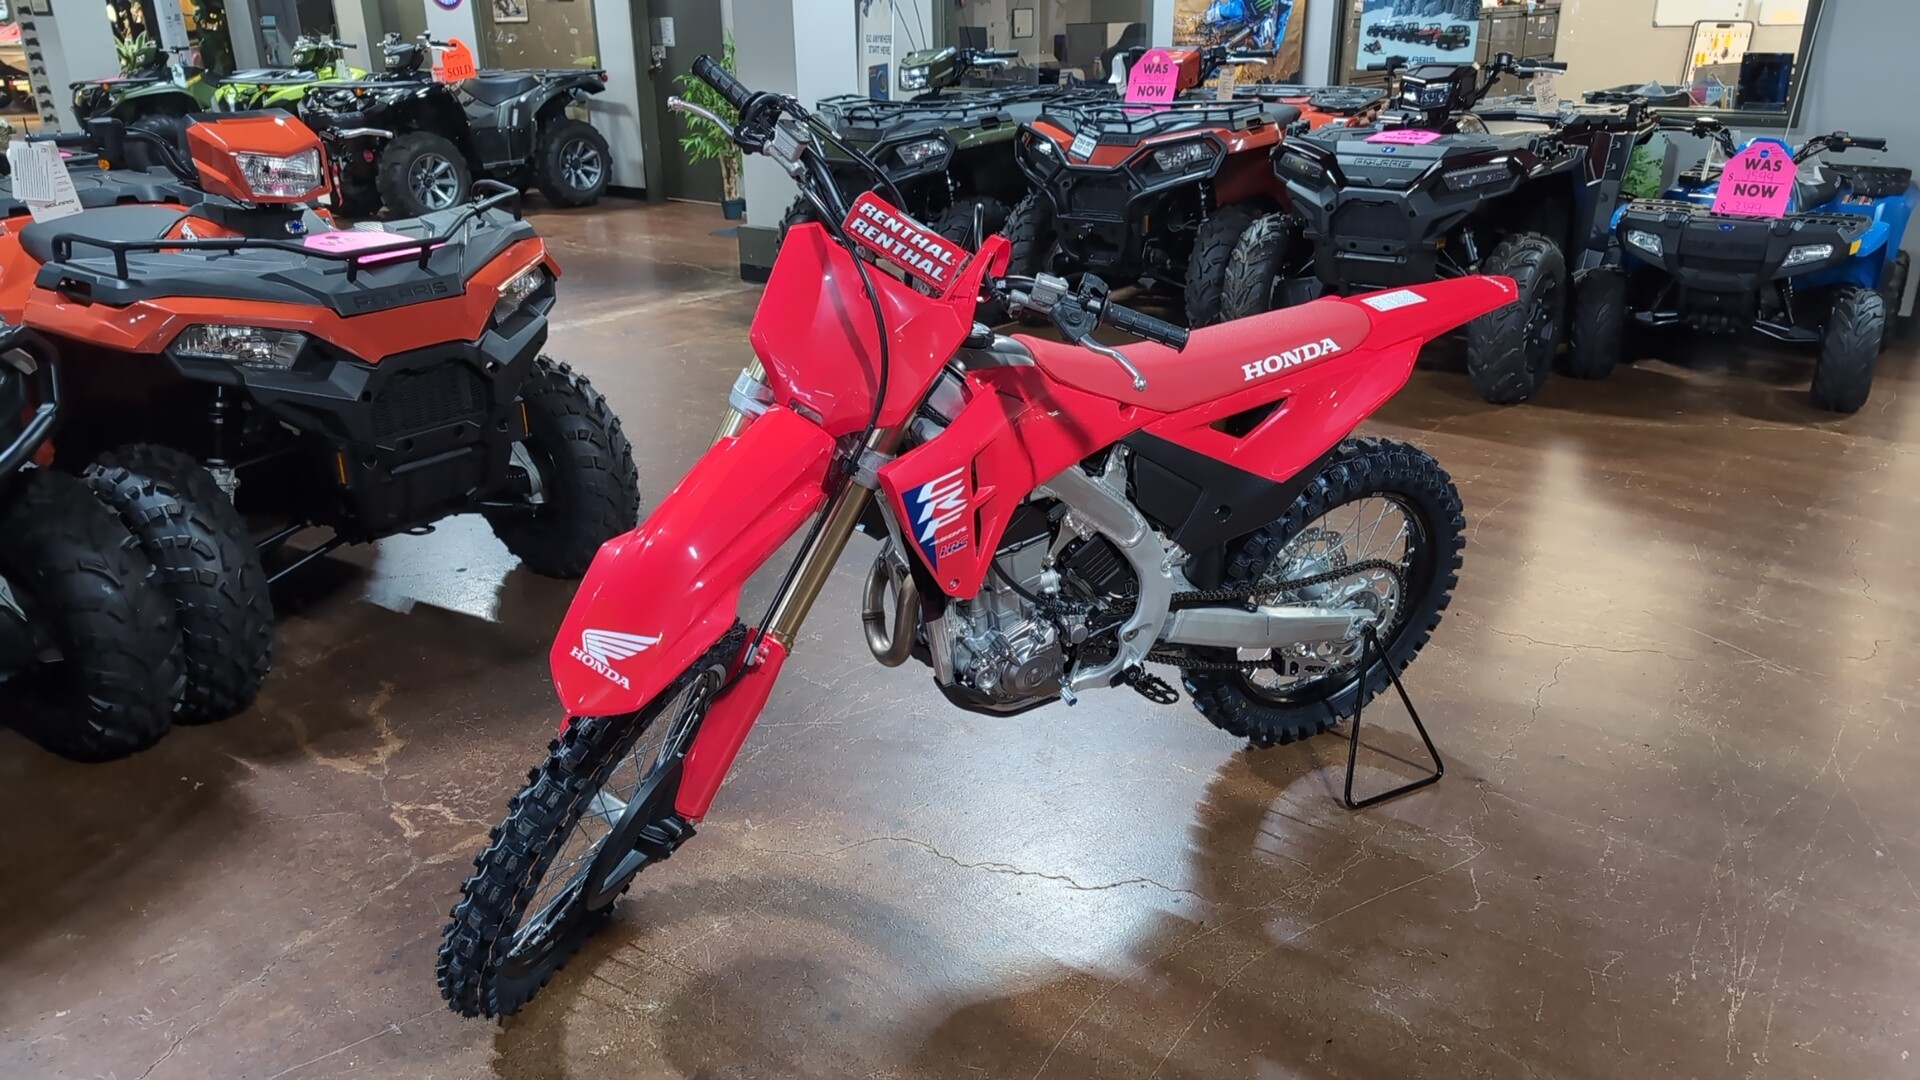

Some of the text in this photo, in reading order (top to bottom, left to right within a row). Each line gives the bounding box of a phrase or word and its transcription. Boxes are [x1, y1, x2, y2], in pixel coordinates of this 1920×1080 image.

[446, 64, 472, 79] SOLD
[1142, 62, 1169, 75] WAS
[1136, 85, 1167, 97] NOW
[1353, 157, 1413, 168] POLARIS
[1745, 157, 1783, 172] WAS
[1727, 171, 1735, 182] $
[1733, 183, 1779, 198] NOW
[1719, 201, 1727, 213] $
[858, 202, 953, 266] RENTHAL
[849, 217, 946, 282] RENTHAL
[352, 280, 449, 309] POLARIS
[1241, 337, 1342, 381] HONDA
[916, 465, 969, 544] CRF
[569, 645, 631, 691] HONDA
